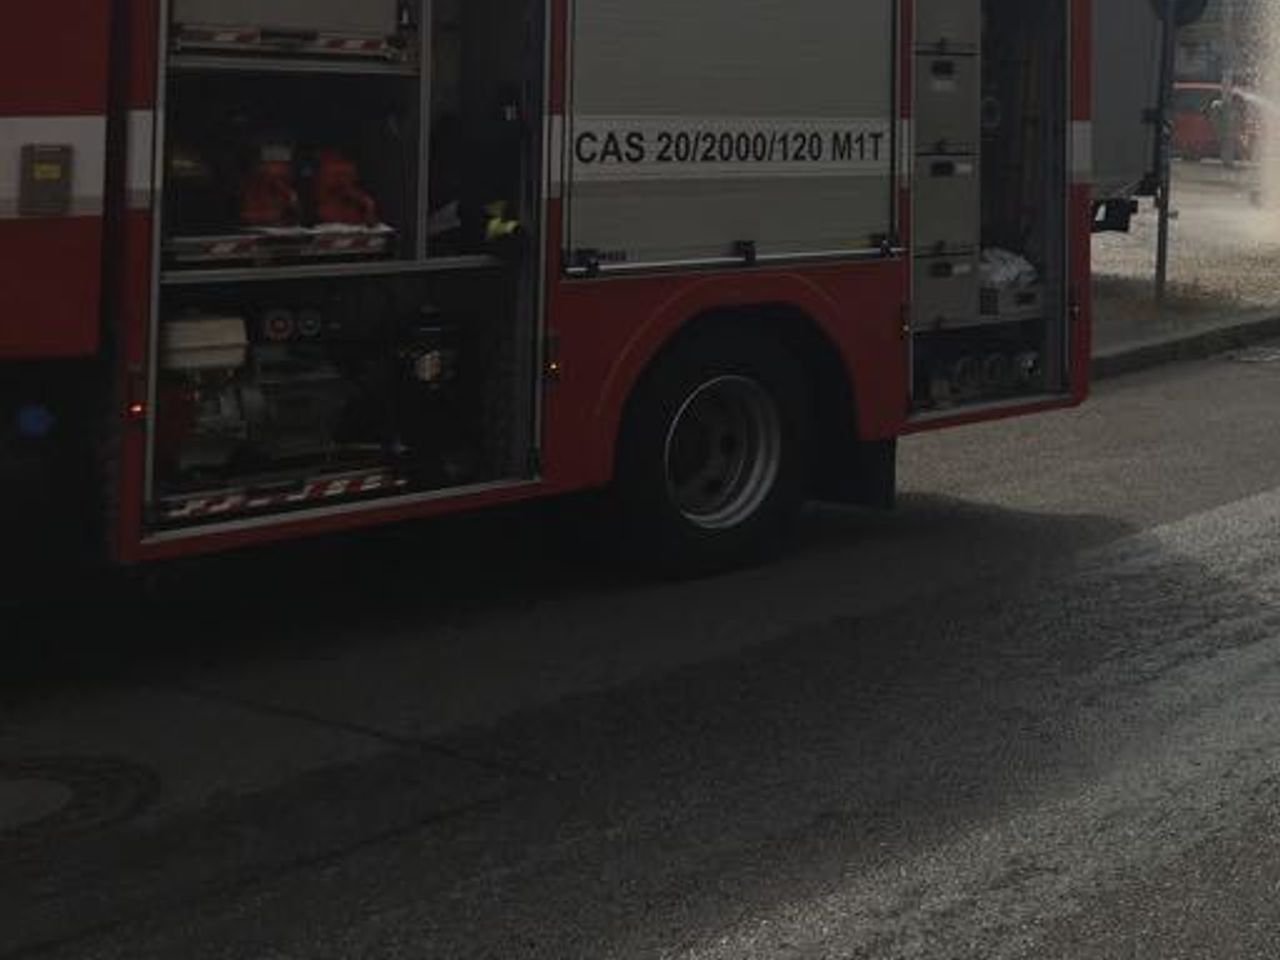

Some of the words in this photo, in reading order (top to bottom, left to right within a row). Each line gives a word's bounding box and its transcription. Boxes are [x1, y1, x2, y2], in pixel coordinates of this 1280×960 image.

[574, 132, 647, 164] CAS
[656, 131, 824, 163] 20/2000/120
[831, 131, 885, 161] M1T
